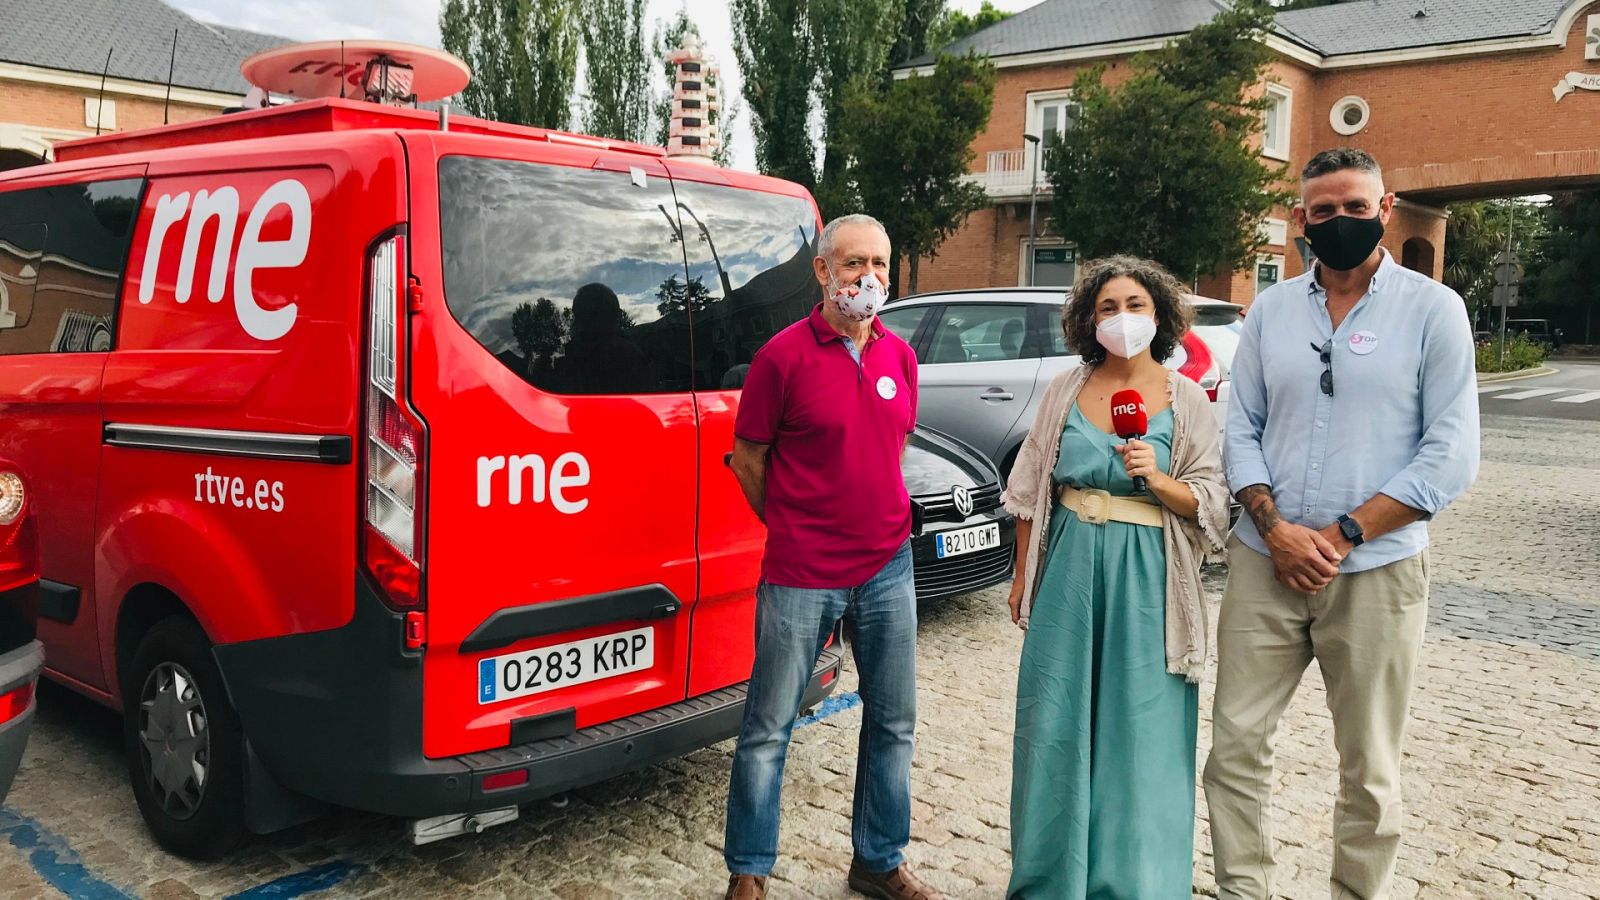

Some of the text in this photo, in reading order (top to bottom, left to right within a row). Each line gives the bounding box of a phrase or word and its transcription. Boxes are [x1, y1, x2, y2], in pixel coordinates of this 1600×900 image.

[138, 178, 312, 341] rne
[1113, 402, 1137, 416] rne
[194, 466, 284, 512] rtve.es
[476, 451, 591, 515] rne
[945, 526, 997, 553] 8210 GWF
[503, 634, 647, 692] 0283 KRP
[484, 685, 492, 695] E
